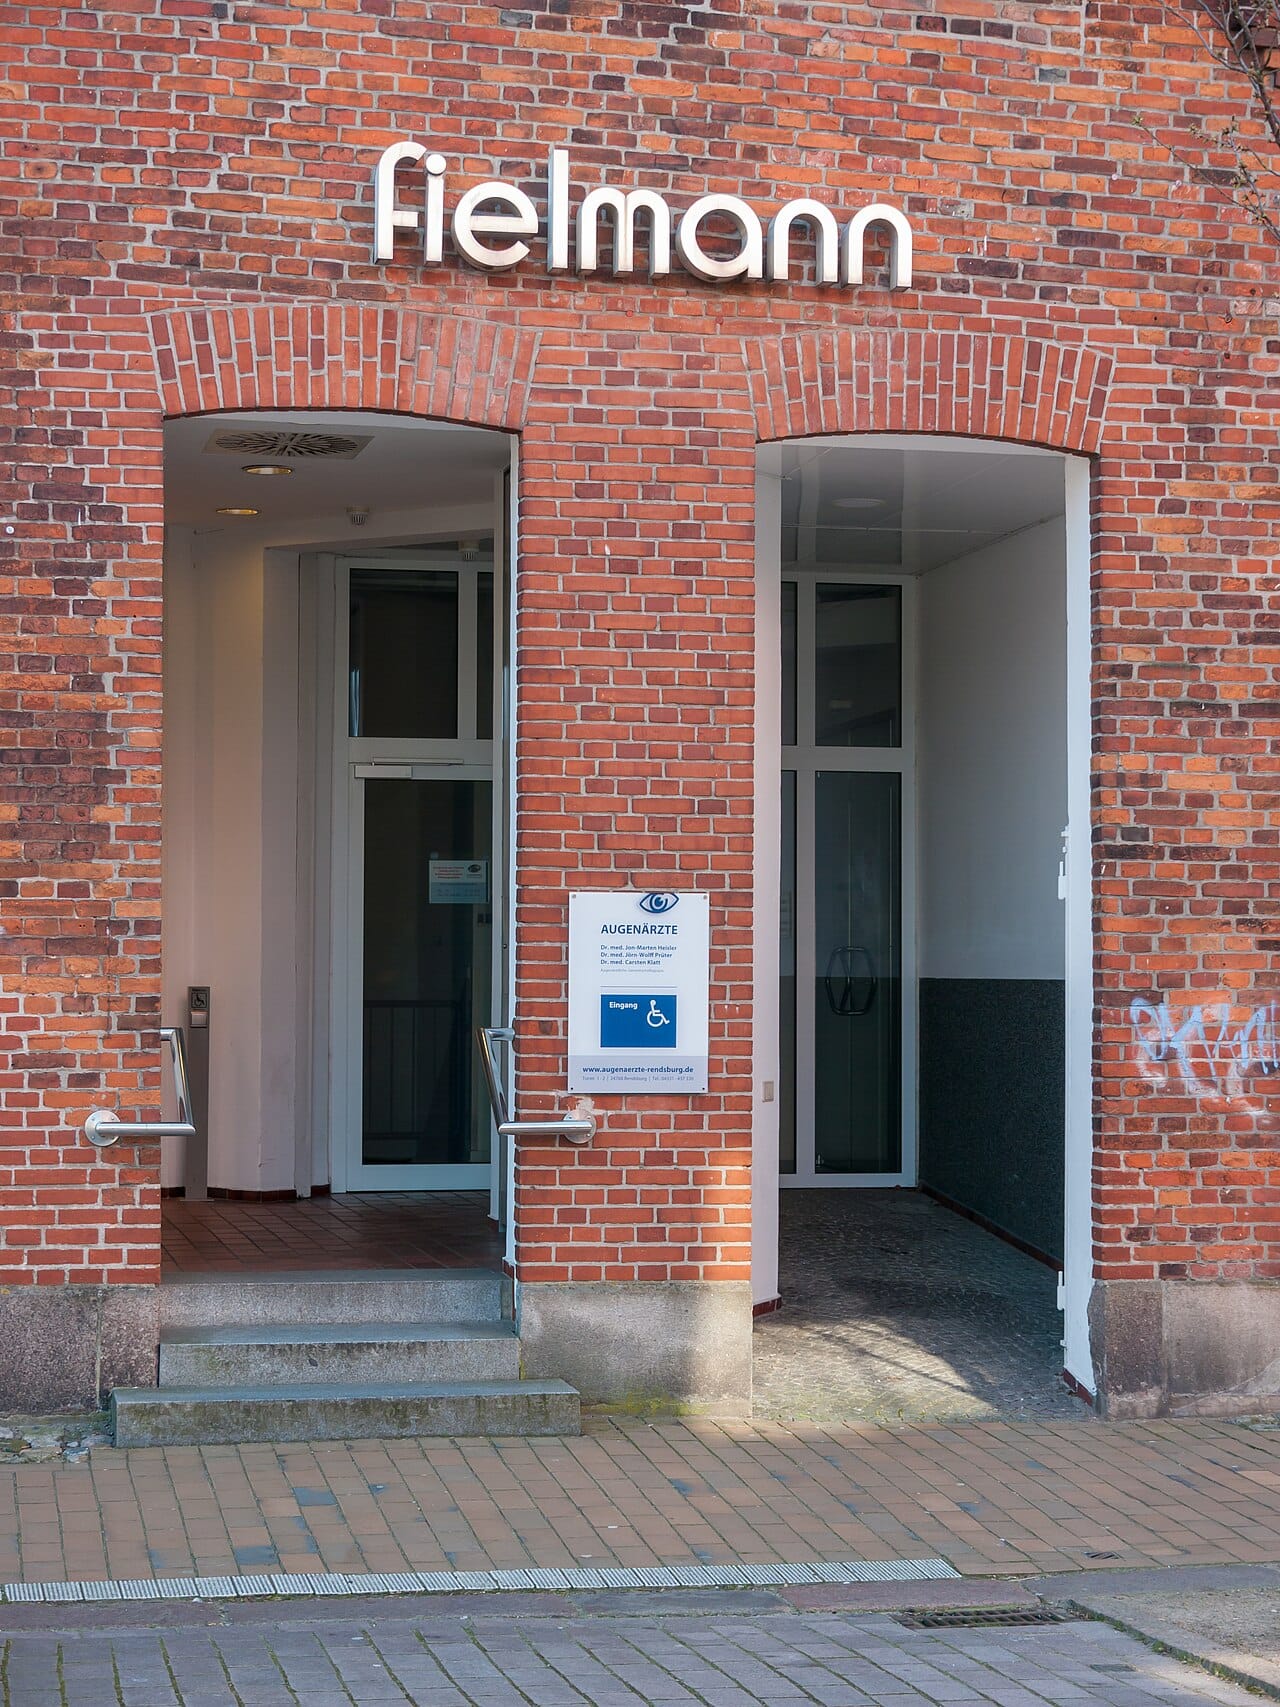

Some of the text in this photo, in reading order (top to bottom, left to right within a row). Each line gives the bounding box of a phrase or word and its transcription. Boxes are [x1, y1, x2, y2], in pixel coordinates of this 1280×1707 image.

[374, 141, 913, 289] fielmann
[600, 923, 678, 935] AUGENÄRZTE
[609, 1001, 638, 1010] Eingang
[582, 1065, 694, 1075] www.augenaerzte-rendsburg.de
